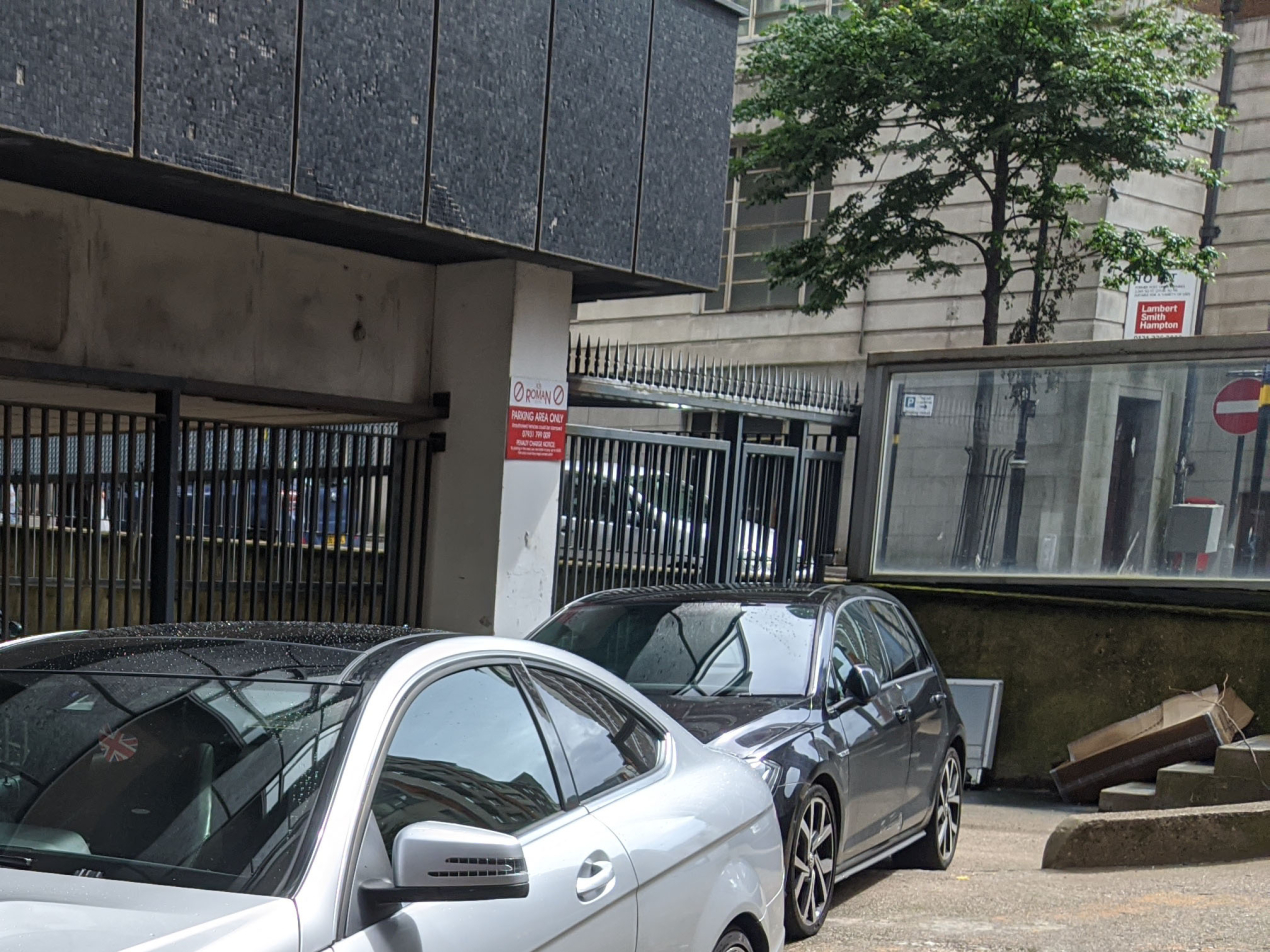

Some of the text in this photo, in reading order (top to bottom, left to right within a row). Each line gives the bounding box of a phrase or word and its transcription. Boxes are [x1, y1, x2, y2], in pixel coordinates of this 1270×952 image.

[1141, 313, 1165, 321] Smith
[1140, 321, 1178, 330] Hampton
[525, 388, 551, 404] ROMAN
[511, 410, 564, 423] PARKING AREA ONLY
